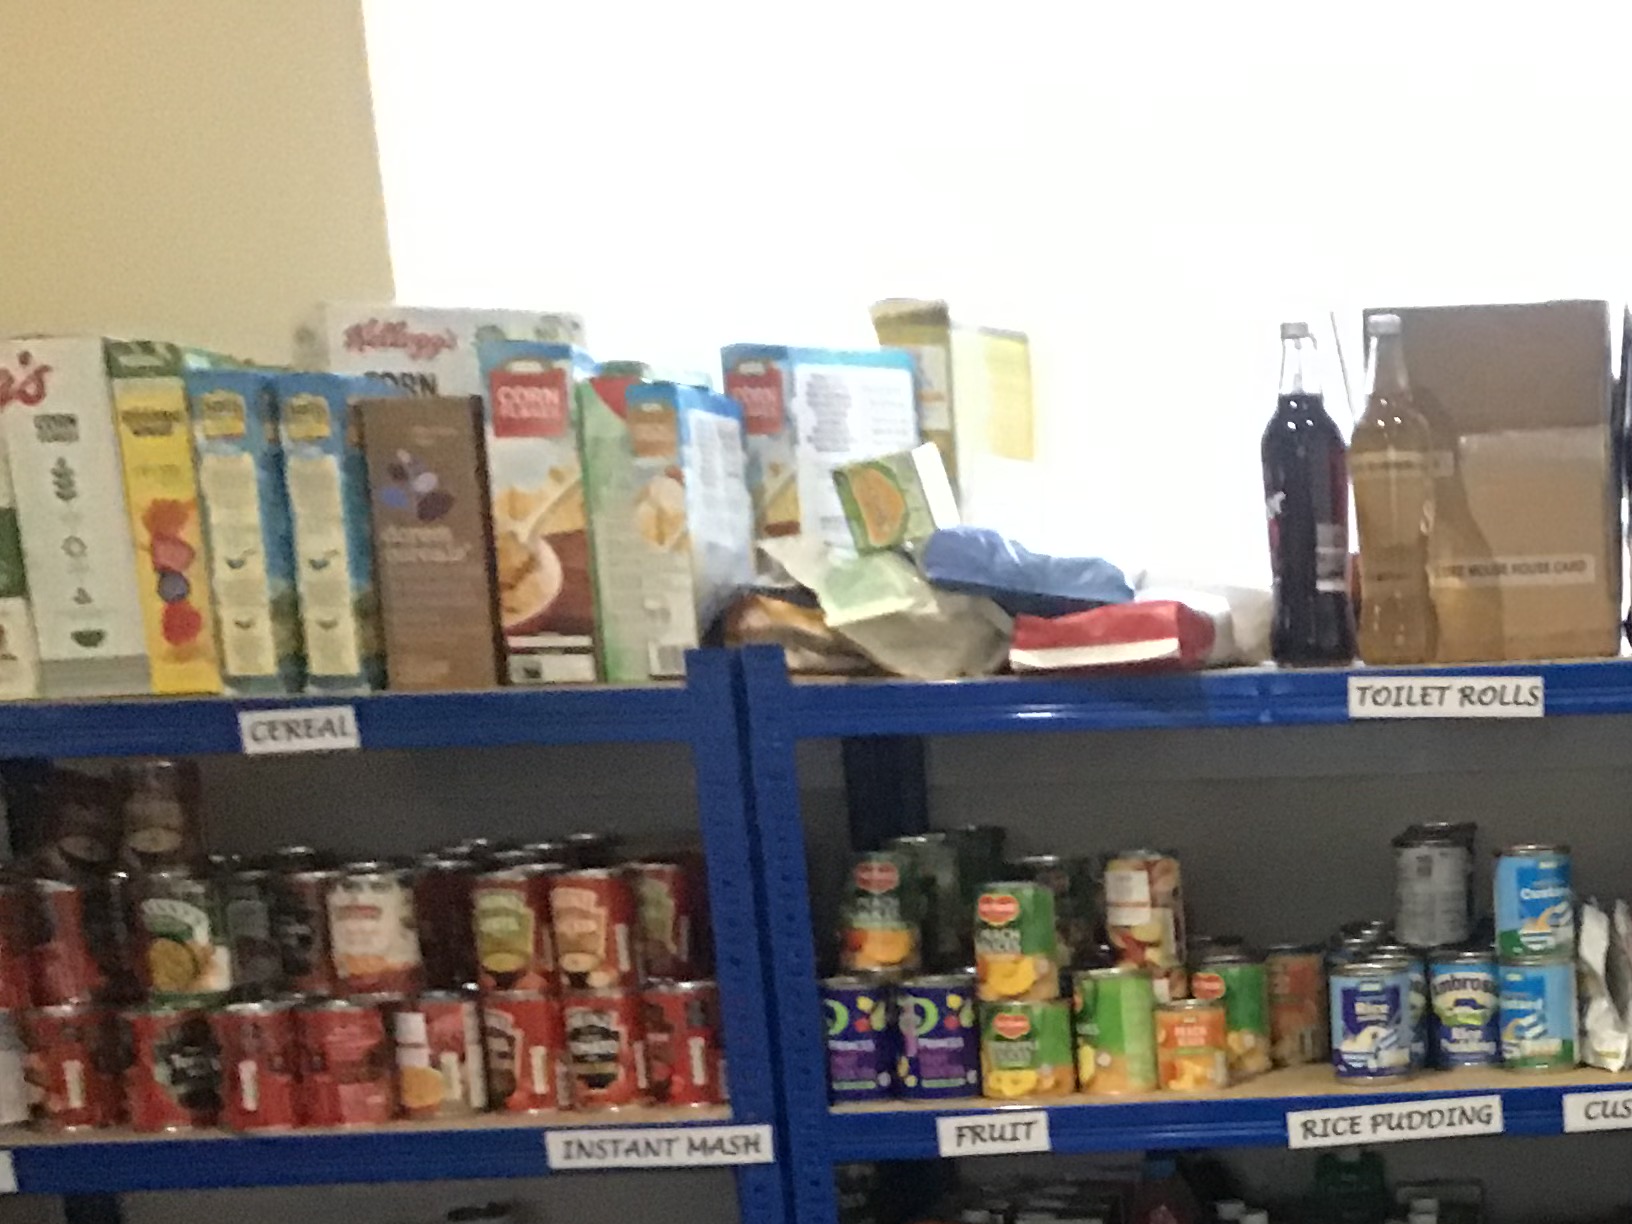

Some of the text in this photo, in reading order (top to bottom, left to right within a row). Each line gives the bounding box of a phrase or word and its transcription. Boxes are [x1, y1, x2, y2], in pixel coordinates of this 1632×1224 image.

[1355, 684, 1541, 708] TOILET ROLLS
[250, 713, 350, 742] CEREAL
[955, 1119, 1039, 1148] FRUIT
[1300, 1103, 1495, 1141] RICE PUDDING
[562, 1132, 764, 1161] INSTANT MASH
